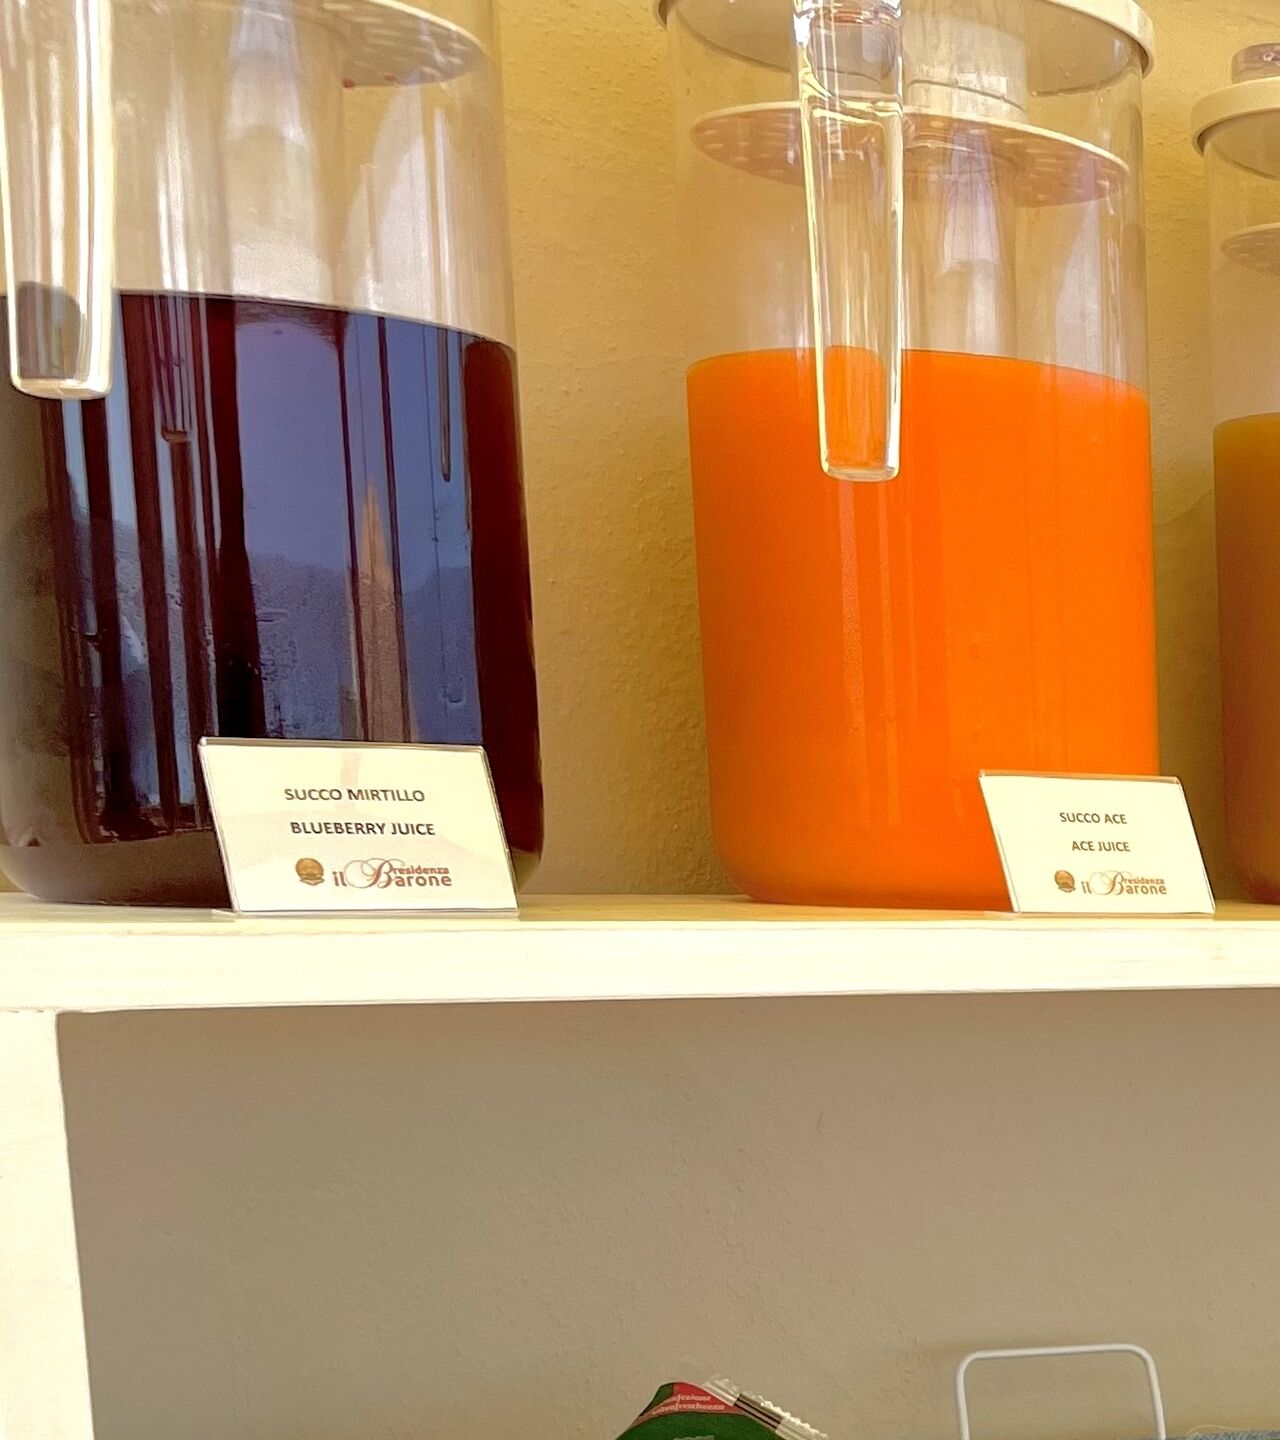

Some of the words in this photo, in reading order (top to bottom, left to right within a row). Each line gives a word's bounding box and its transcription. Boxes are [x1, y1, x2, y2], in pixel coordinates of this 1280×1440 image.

[284, 788, 342, 801] SUCCO
[347, 789, 425, 802] MIRTILLO
[1059, 812, 1101, 824] SUCCO
[1104, 814, 1127, 825] ACE
[290, 821, 386, 835] BLUEBERRY
[391, 822, 436, 836] JUICE
[1071, 840, 1095, 852] ACE
[1098, 841, 1131, 853] JUICE
[332, 870, 347, 887] il
[345, 857, 452, 888] Barone
[1089, 870, 1167, 896] Barone
